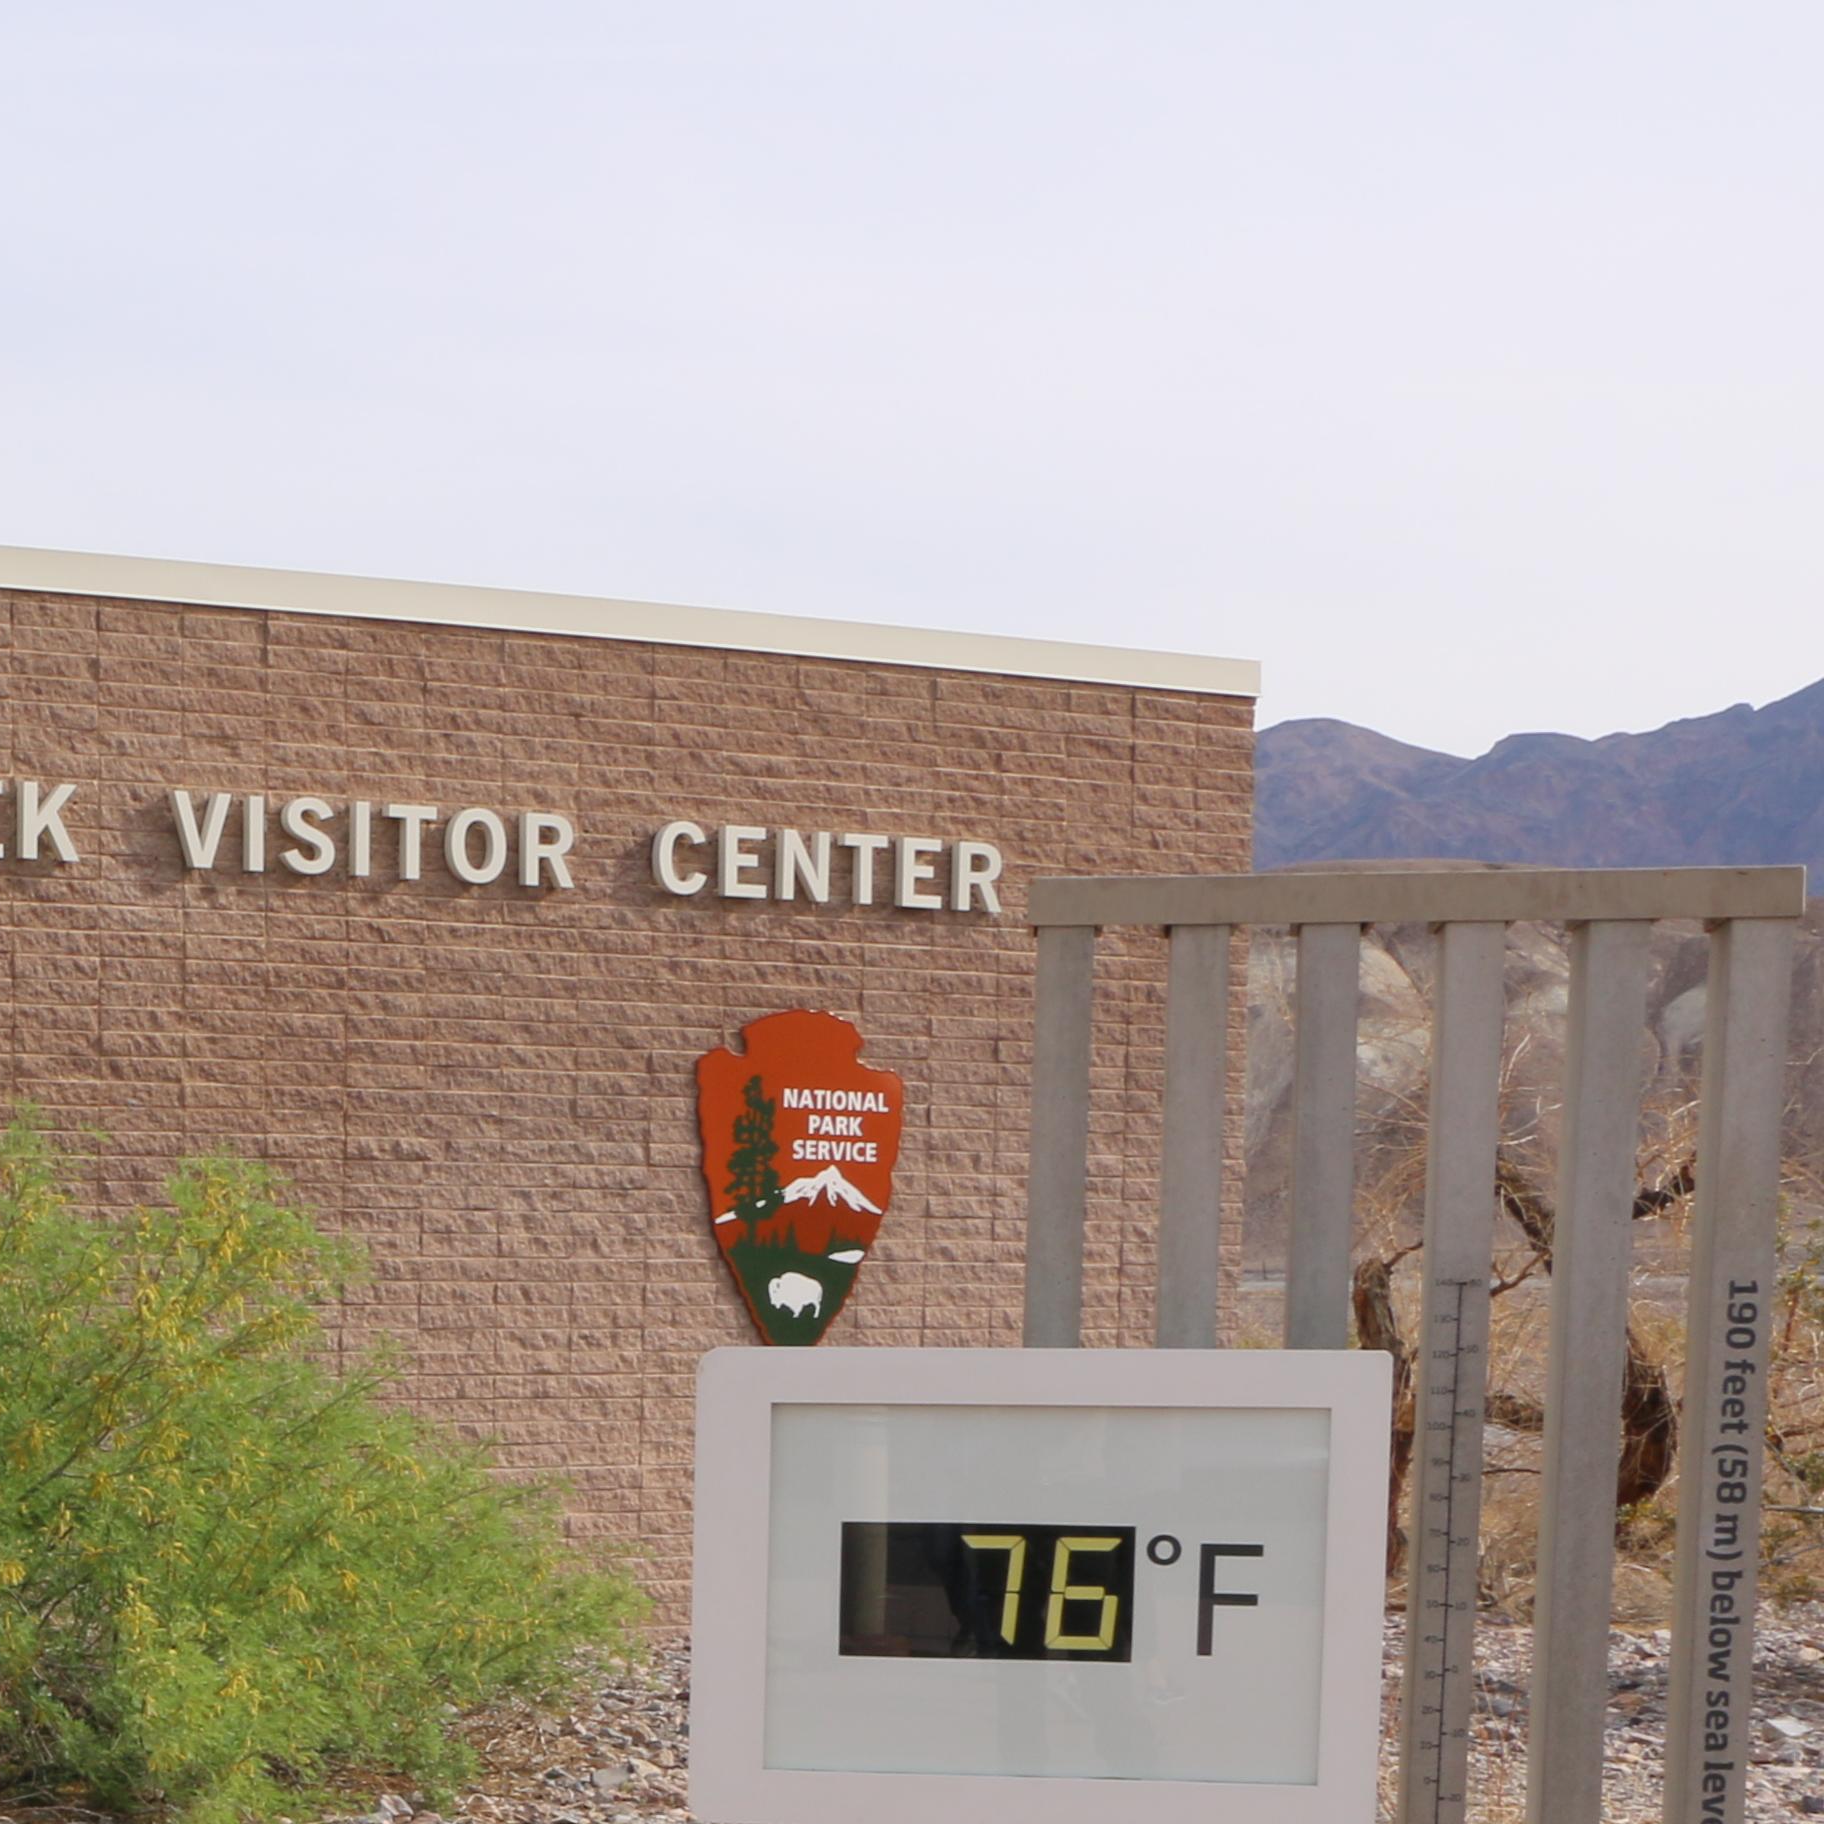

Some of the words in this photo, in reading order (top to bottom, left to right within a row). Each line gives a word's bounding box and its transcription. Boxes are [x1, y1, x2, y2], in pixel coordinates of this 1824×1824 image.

[172, 790, 574, 888] VISITOR
[652, 821, 1002, 912] CENTER
[783, 1088, 889, 1113] NATIONAL
[808, 1114, 863, 1137] PARK
[792, 1139, 877, 1163] SERVICE
[1725, 1279, 1759, 1350] 190
[1720, 1359, 1756, 1435] feet
[1711, 1444, 1749, 1505] (58
[1705, 1513, 1743, 1561] m)
[960, 1535, 1122, 1650] 76
[1145, 1534, 1264, 1656] °F
[1706, 1570, 1743, 1682] below
[1704, 1690, 1730, 1752] sea
